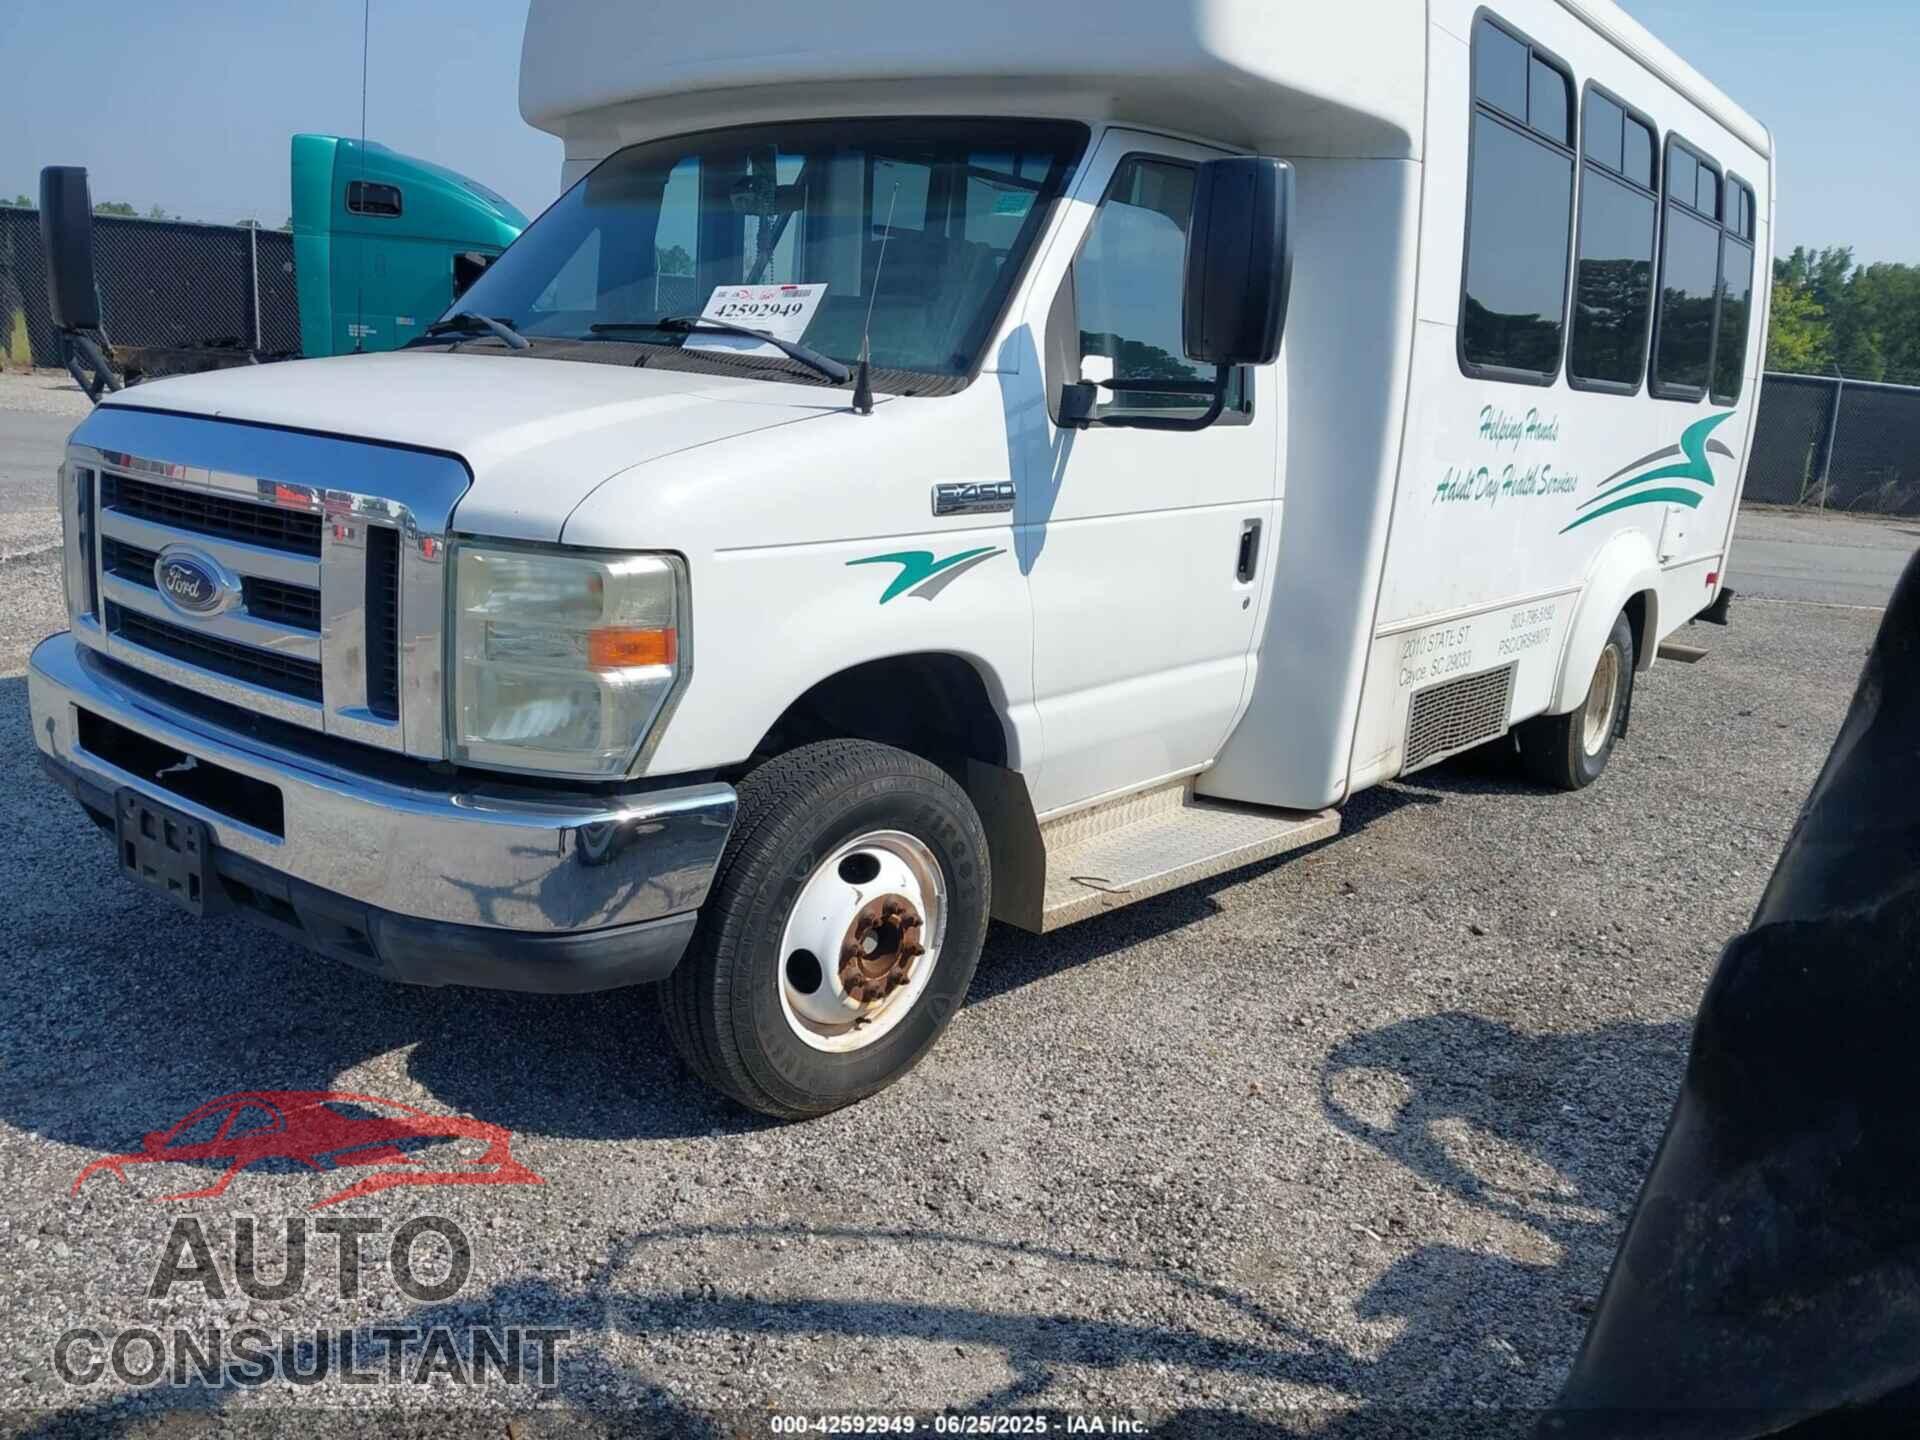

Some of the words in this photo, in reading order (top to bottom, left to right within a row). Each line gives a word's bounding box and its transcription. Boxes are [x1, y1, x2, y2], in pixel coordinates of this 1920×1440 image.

[714, 302, 803, 317] 42592949
[1479, 404, 1523, 453] Helping
[1526, 408, 1560, 441] Hands
[1432, 466, 1475, 505] Adult
[1475, 466, 1500, 508] Day
[1502, 463, 1540, 497] Health
[1537, 463, 1578, 496] Services
[165, 564, 201, 598] Ford
[1427, 627, 1457, 653] STATE
[1458, 624, 1472, 645] ST
